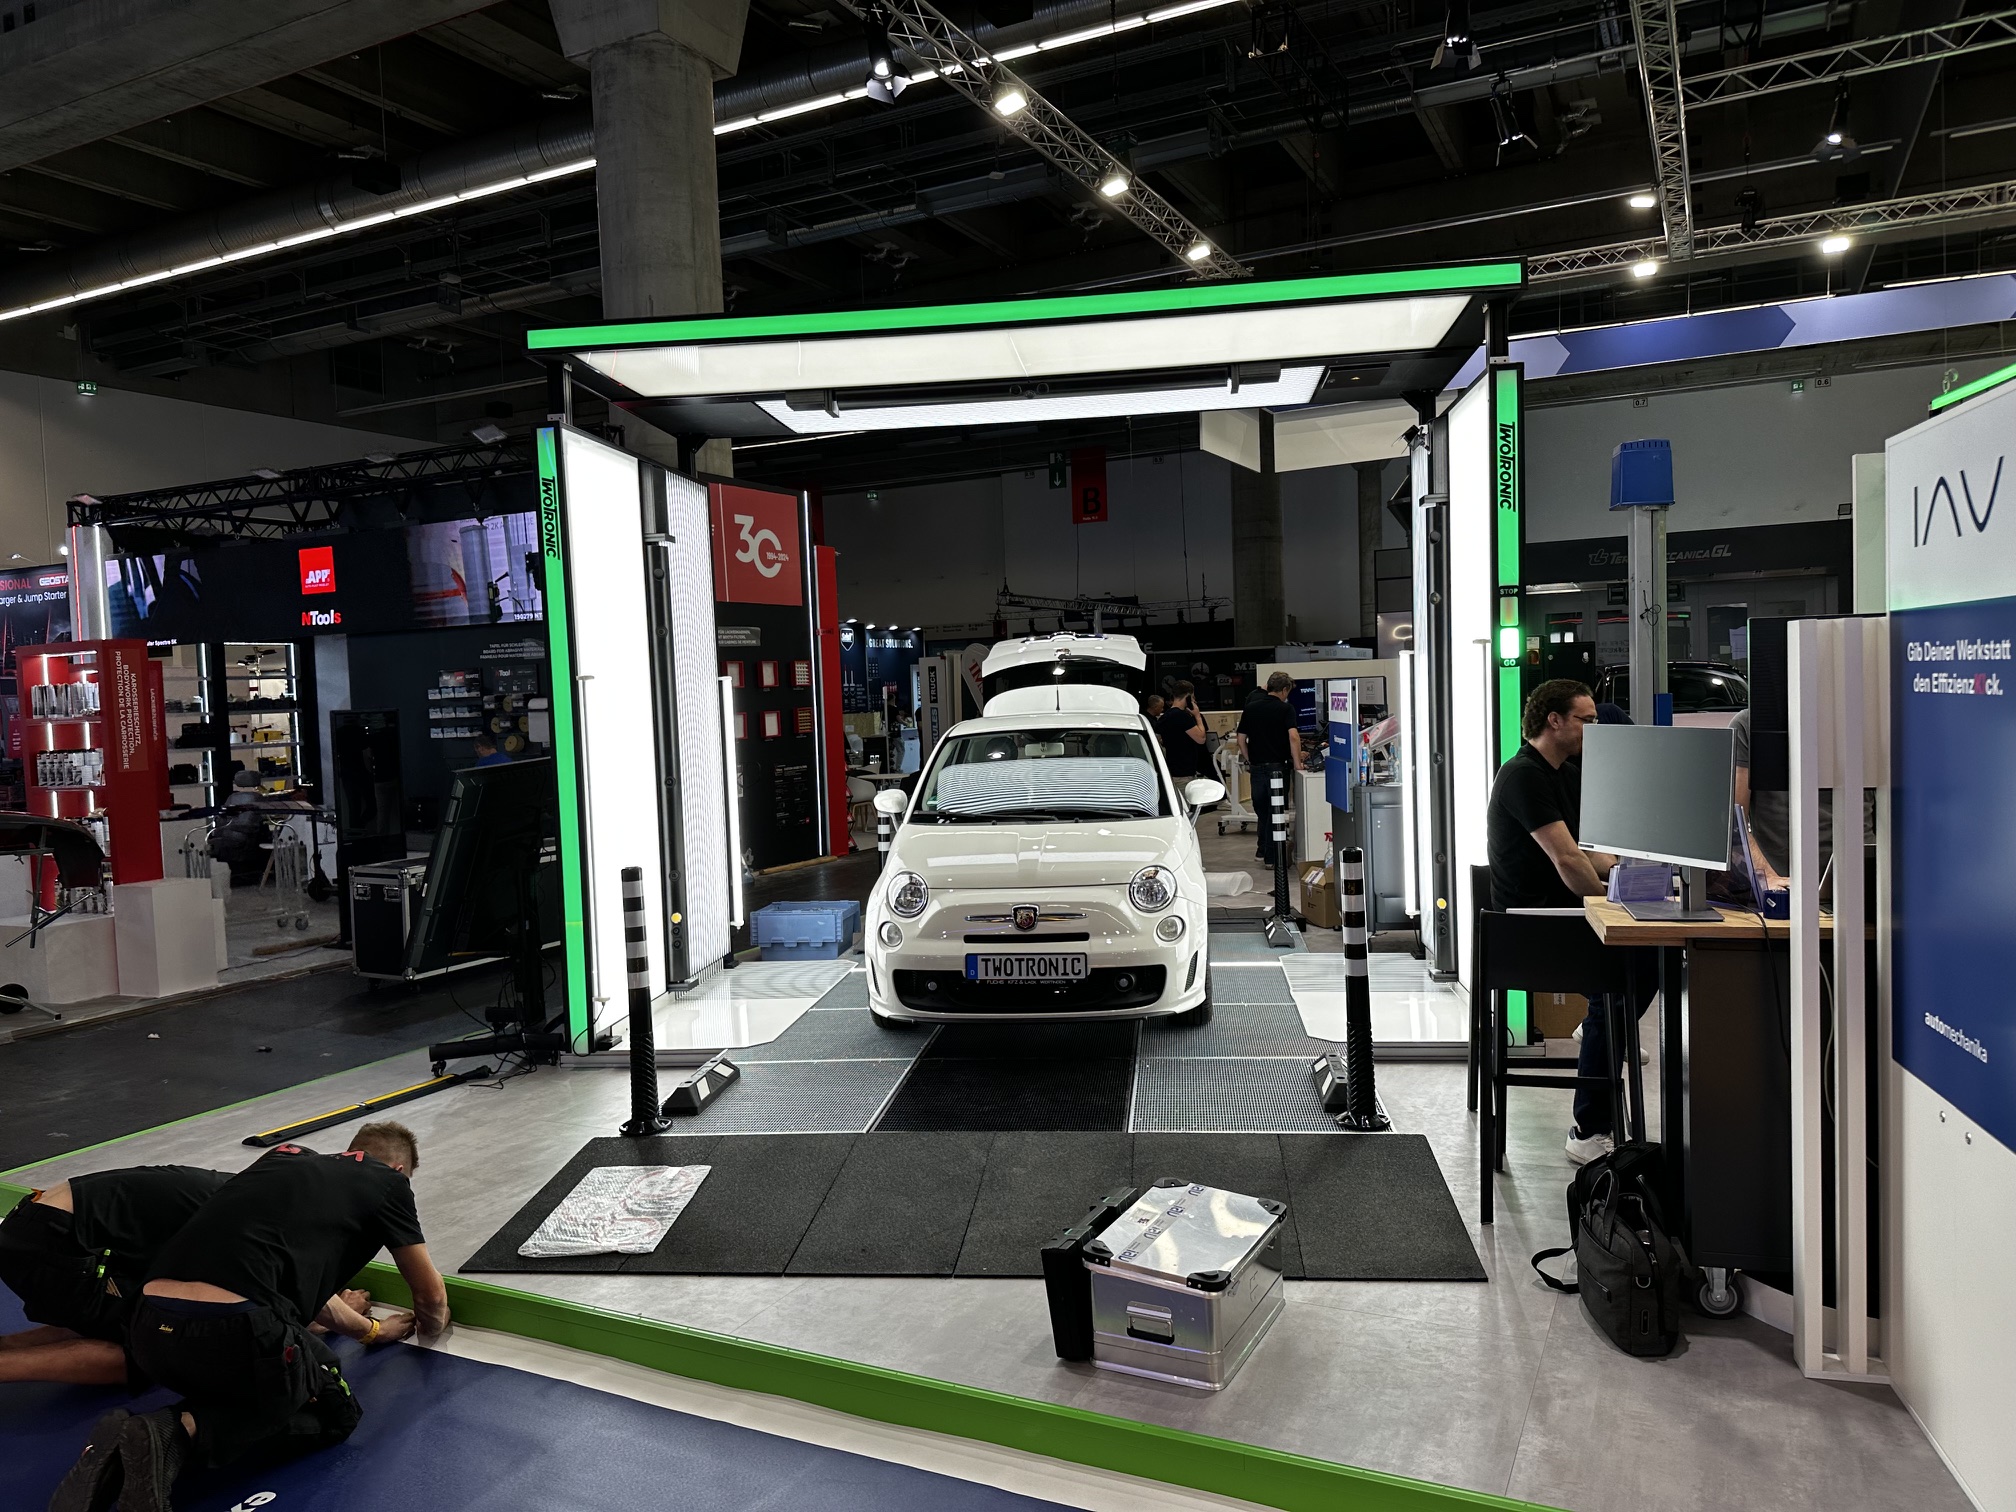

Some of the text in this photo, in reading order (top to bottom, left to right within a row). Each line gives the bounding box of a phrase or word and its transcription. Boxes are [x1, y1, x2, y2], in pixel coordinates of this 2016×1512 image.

[1499, 422, 1516, 512] TWOTRONIC
[1082, 487, 1101, 515] B
[1914, 455, 2004, 548] IAV
[541, 476, 560, 560] TWOTRONIC
[17, 594, 23, 603] &
[23, 593, 43, 605] Jump
[43, 590, 67, 601] Starter
[302, 609, 342, 626] NTools
[868, 638, 885, 648] GREAT
[1907, 638, 2011, 661] Gib Deiner Werkstatt
[929, 670, 938, 701] TRUCK
[1913, 673, 1931, 692] den
[115, 651, 129, 769] PROTECTION DE LA CARROSSERIE
[123, 664, 135, 756] BODYWORK PROTECTION,
[981, 957, 1082, 977] TWOTRONIC
[1925, 1012, 1988, 1064] automechanika
